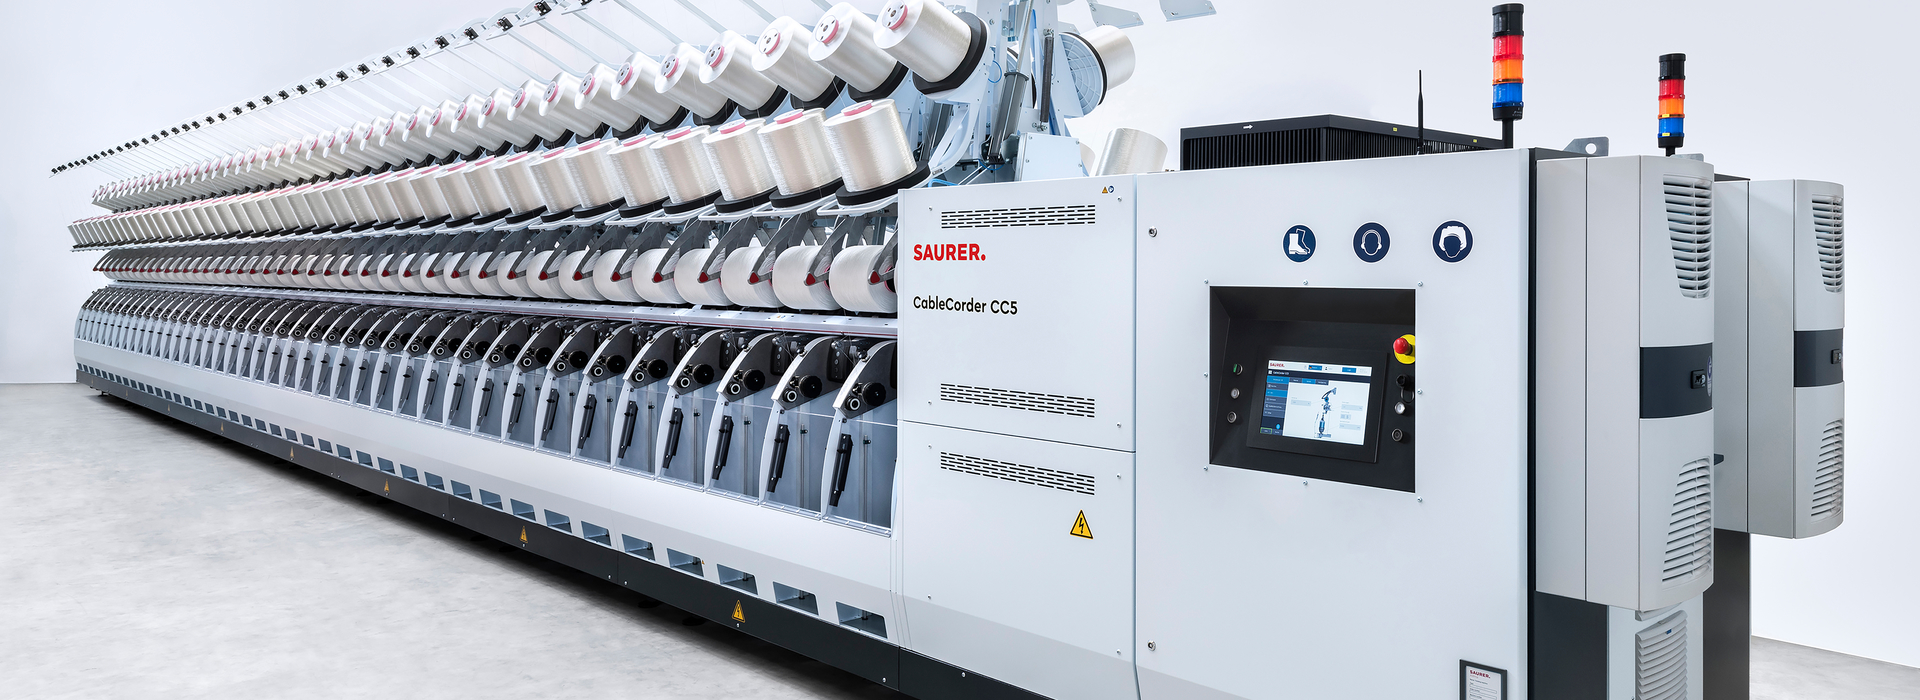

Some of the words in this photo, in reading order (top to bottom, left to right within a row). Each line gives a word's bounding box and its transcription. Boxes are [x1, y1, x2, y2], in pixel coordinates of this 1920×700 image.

[913, 243, 986, 261] SAURER.
[913, 295, 987, 313] CableCorder
[990, 299, 1018, 315] CC5
